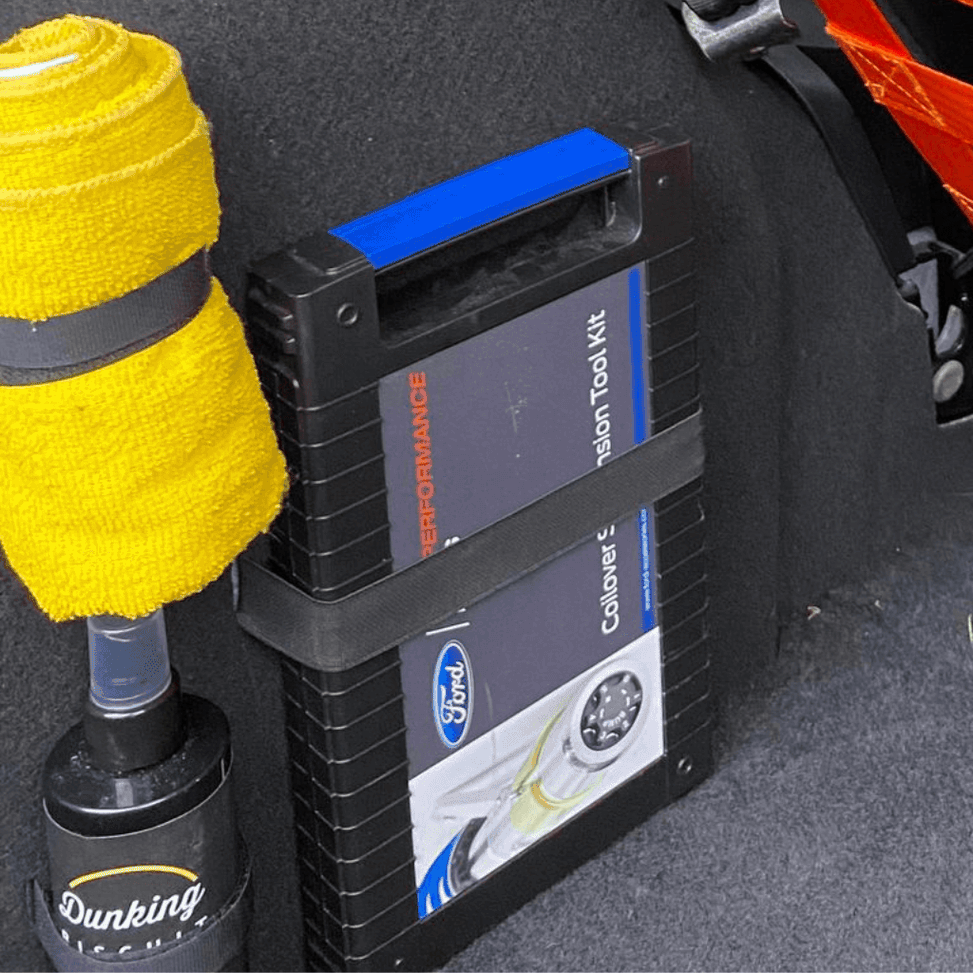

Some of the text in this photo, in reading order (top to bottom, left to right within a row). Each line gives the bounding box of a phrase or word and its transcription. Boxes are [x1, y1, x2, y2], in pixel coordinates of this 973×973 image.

[587, 309, 620, 634] Coilover Snsion Tool Kit
[440, 661, 466, 724] Ford
[59, 882, 205, 930] Dunking
